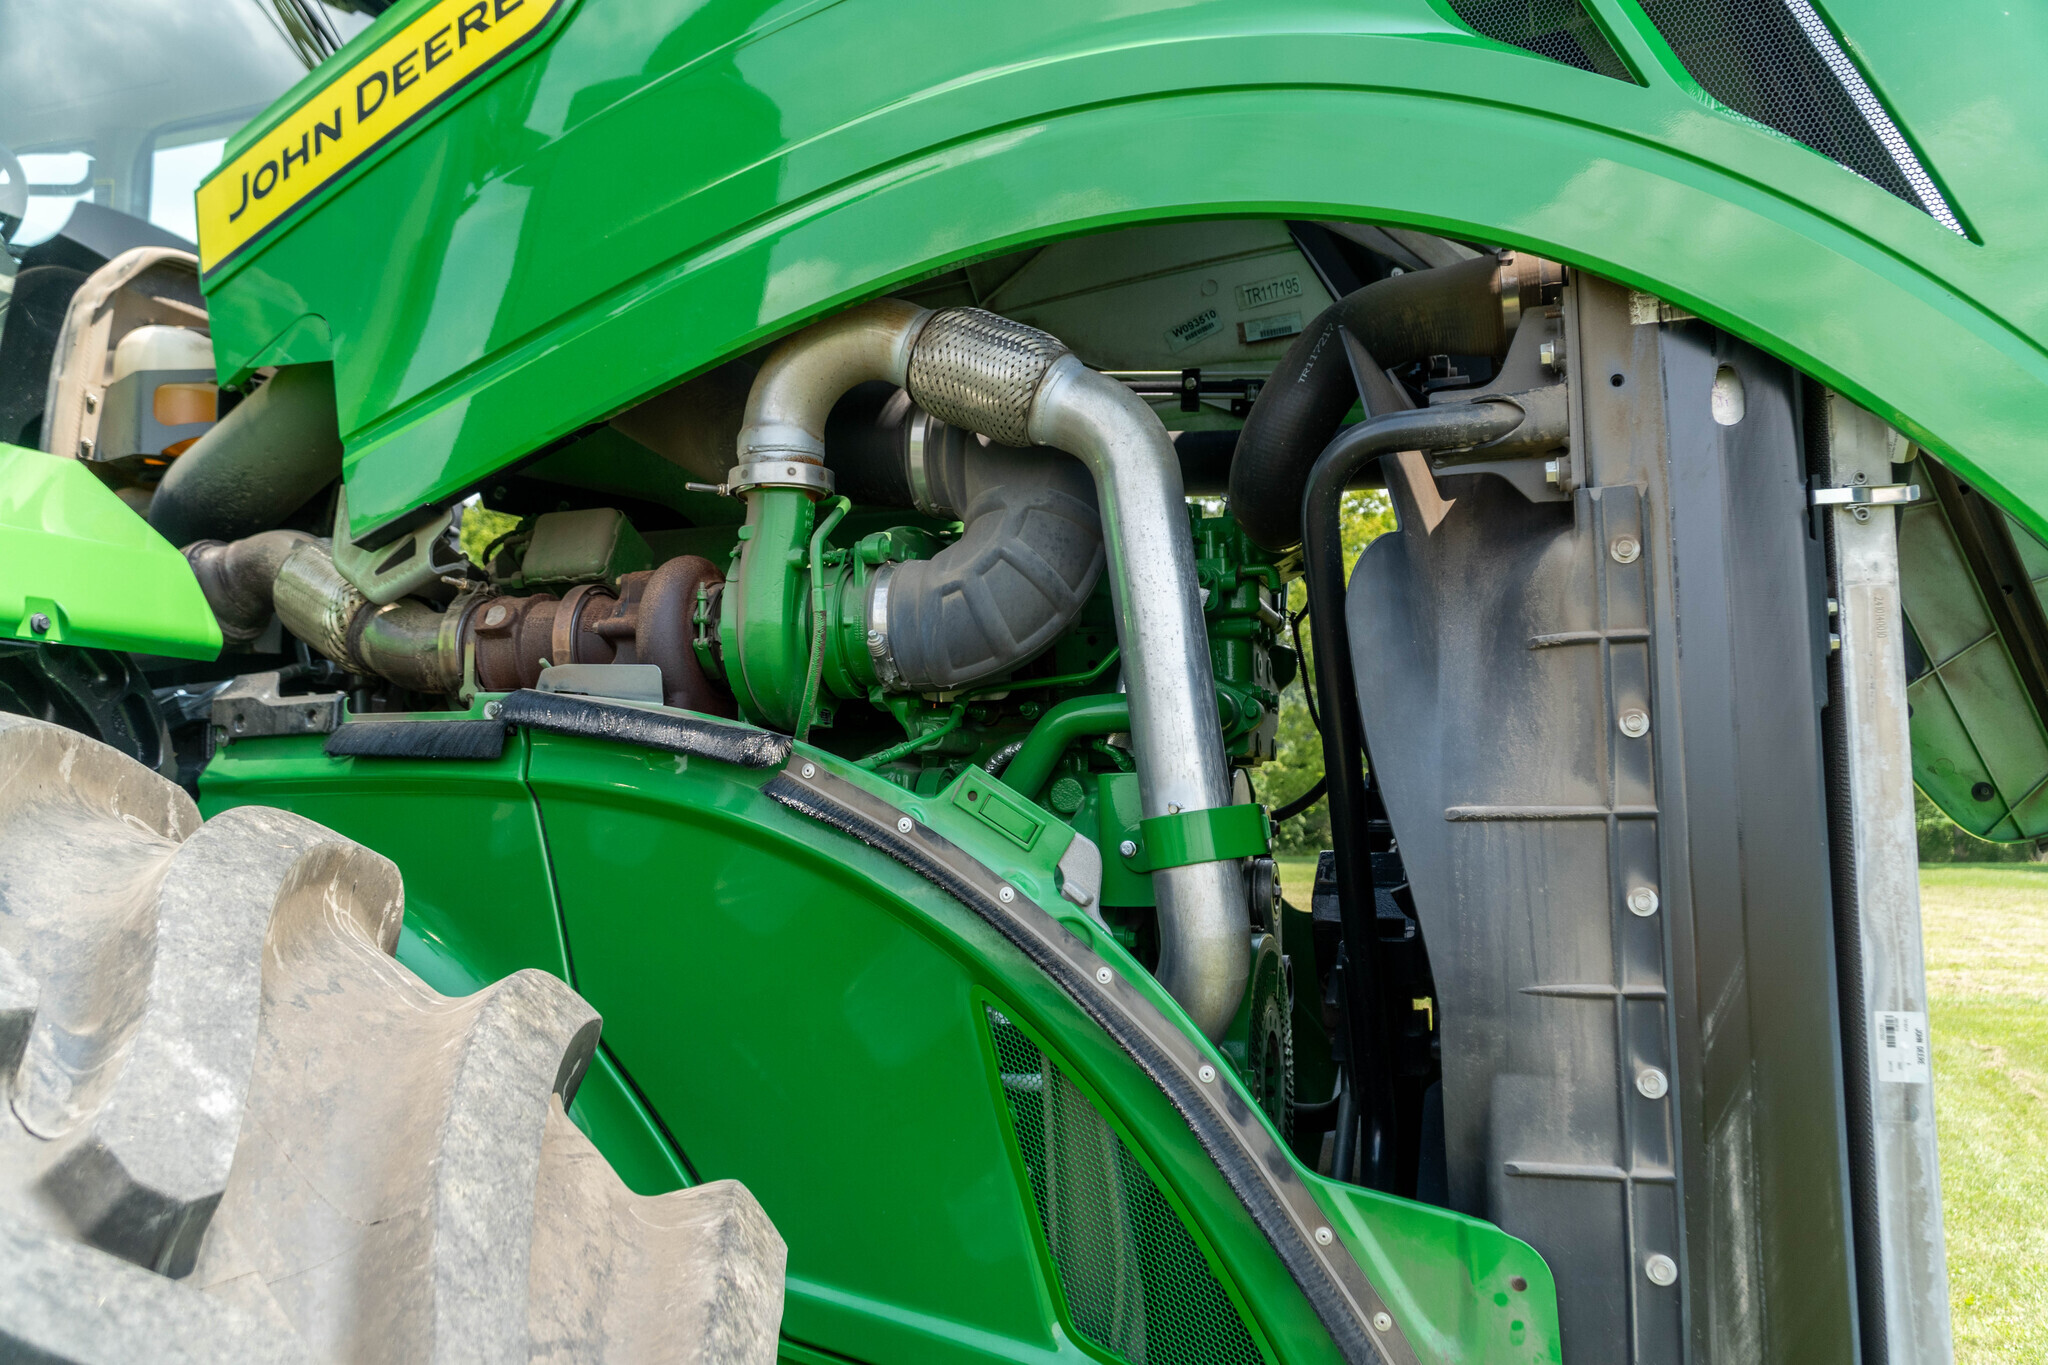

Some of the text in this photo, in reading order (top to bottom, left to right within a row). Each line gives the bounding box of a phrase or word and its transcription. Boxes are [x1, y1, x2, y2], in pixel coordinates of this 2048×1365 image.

[229, 106, 342, 223] JOHN
[1245, 277, 1300, 304] TR117195
[1172, 309, 1217, 338] W093510
[1297, 322, 1334, 384] TR117217
